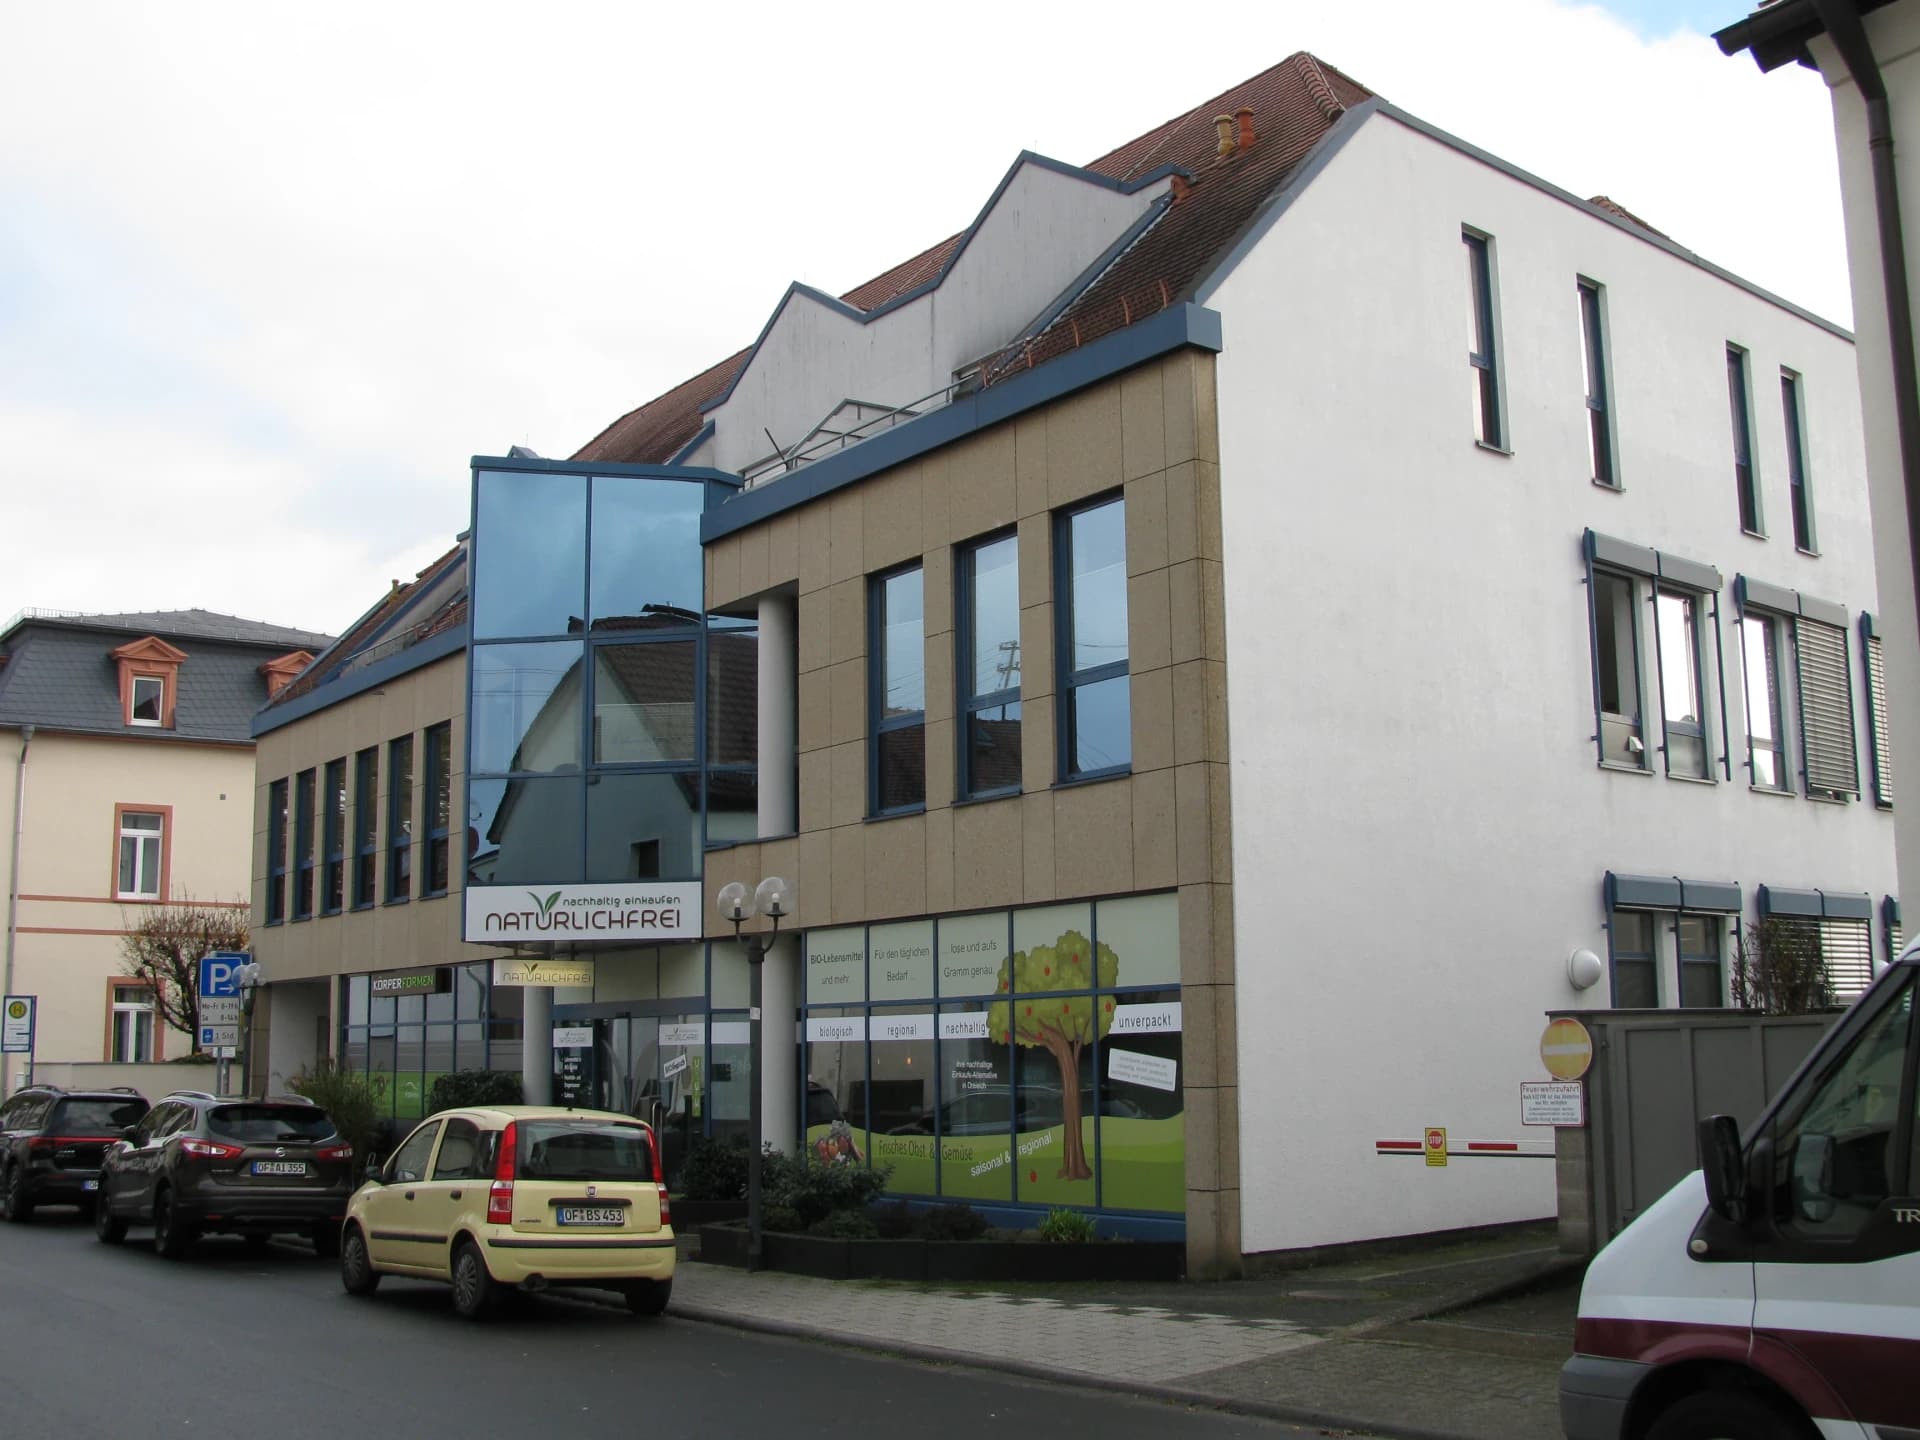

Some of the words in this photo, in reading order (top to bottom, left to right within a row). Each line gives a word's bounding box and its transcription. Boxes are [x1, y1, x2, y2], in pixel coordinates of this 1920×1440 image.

[563, 896, 620, 908] nachhaltig
[624, 895, 681, 906] einkaufen
[967, 942, 981, 953] und
[210, 963, 232, 994] P
[943, 967, 970, 978] Gramm
[1119, 1013, 1172, 1030] unverpackt
[819, 1026, 853, 1040] biologisch
[887, 1024, 917, 1038] regional
[945, 1022, 986, 1036] nachhaltig
[1428, 1135, 1443, 1145] STOP
[878, 1139, 908, 1156] Frisches
[941, 1144, 974, 1161] Gemüse
[970, 1153, 1004, 1177] saisonal
[1017, 1132, 1053, 1156] regional
[564, 1208, 579, 1221] OF
[586, 1208, 601, 1221] BS
[602, 1208, 623, 1221] 453
